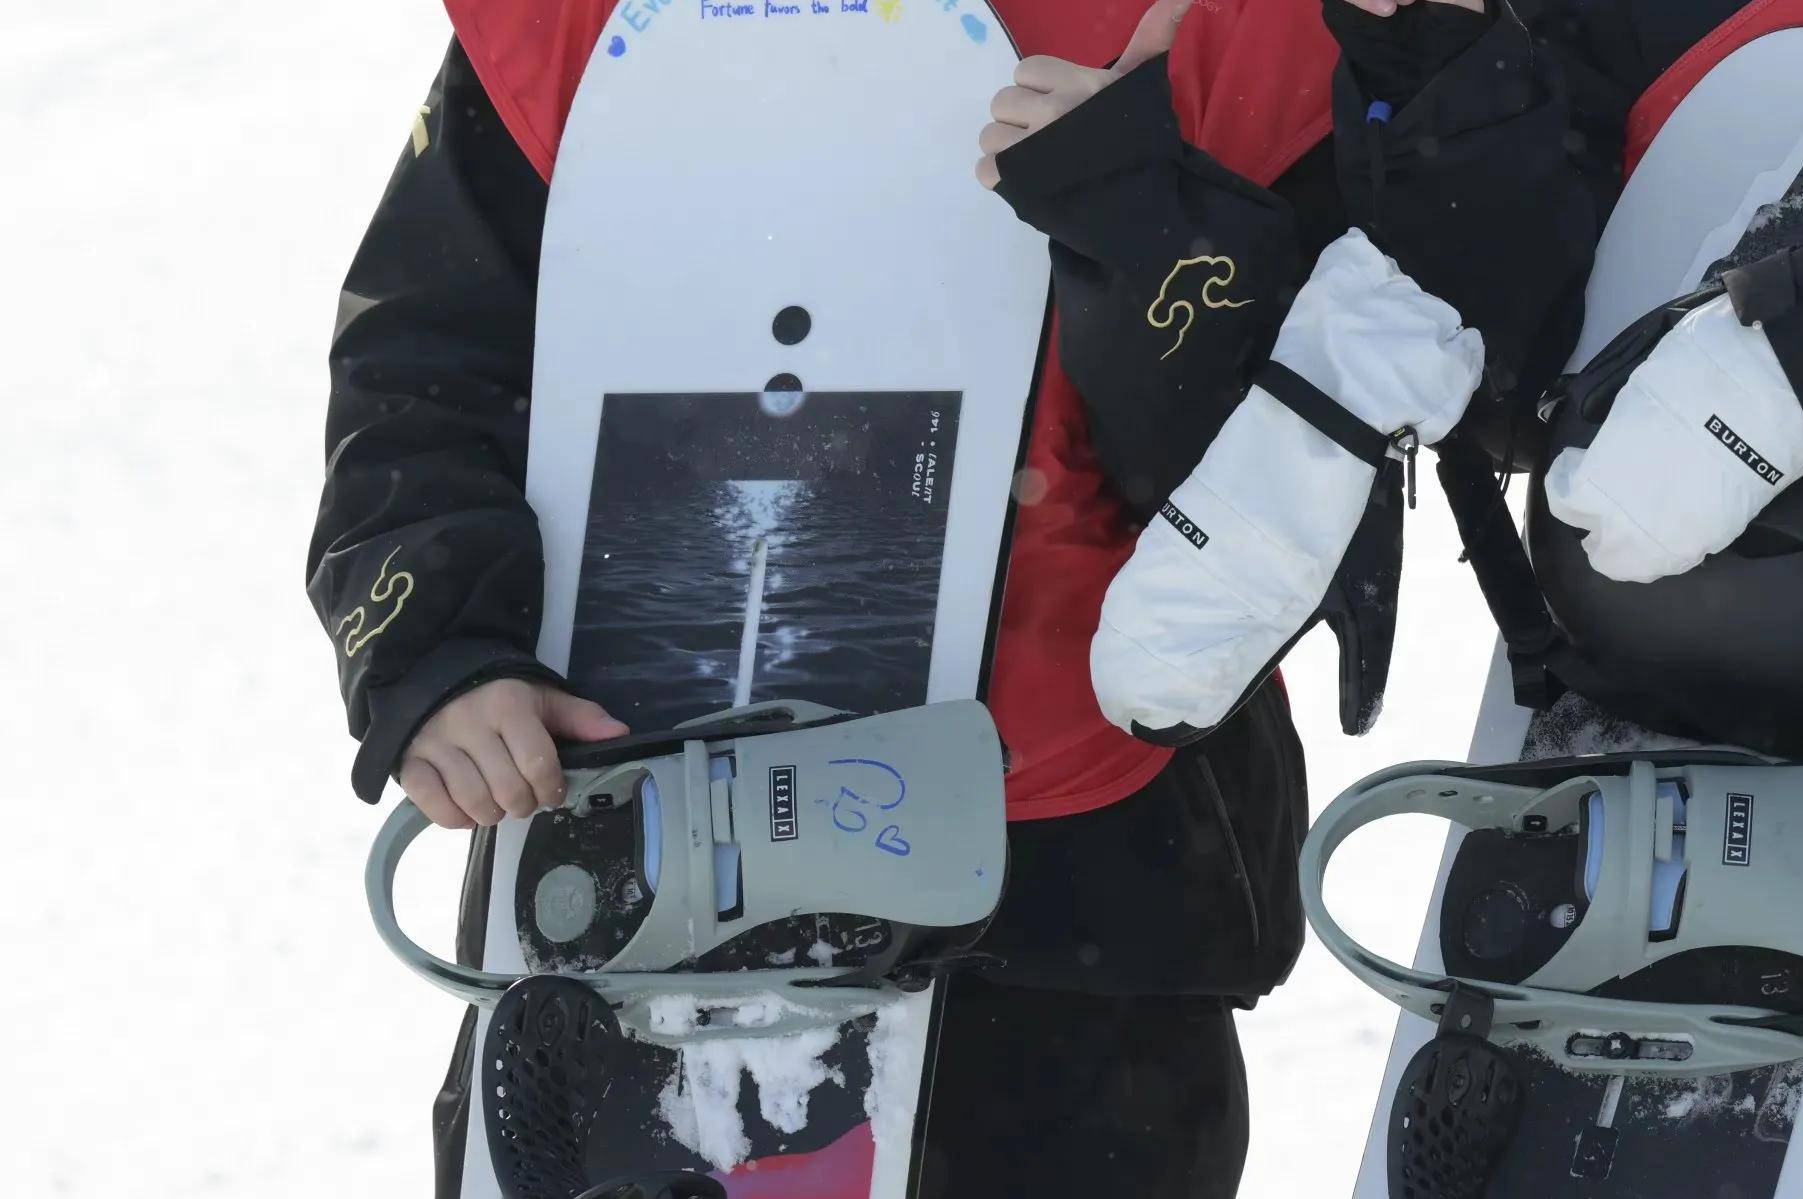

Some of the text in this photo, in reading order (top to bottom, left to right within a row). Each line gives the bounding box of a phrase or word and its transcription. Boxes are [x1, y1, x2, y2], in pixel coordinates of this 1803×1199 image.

[811, 0, 830, 14] the
[1709, 418, 1780, 483] BURTON
[1161, 502, 1206, 546] URTON
[776, 775, 790, 833] LEXA X
[1730, 802, 1746, 859] LEXA X
